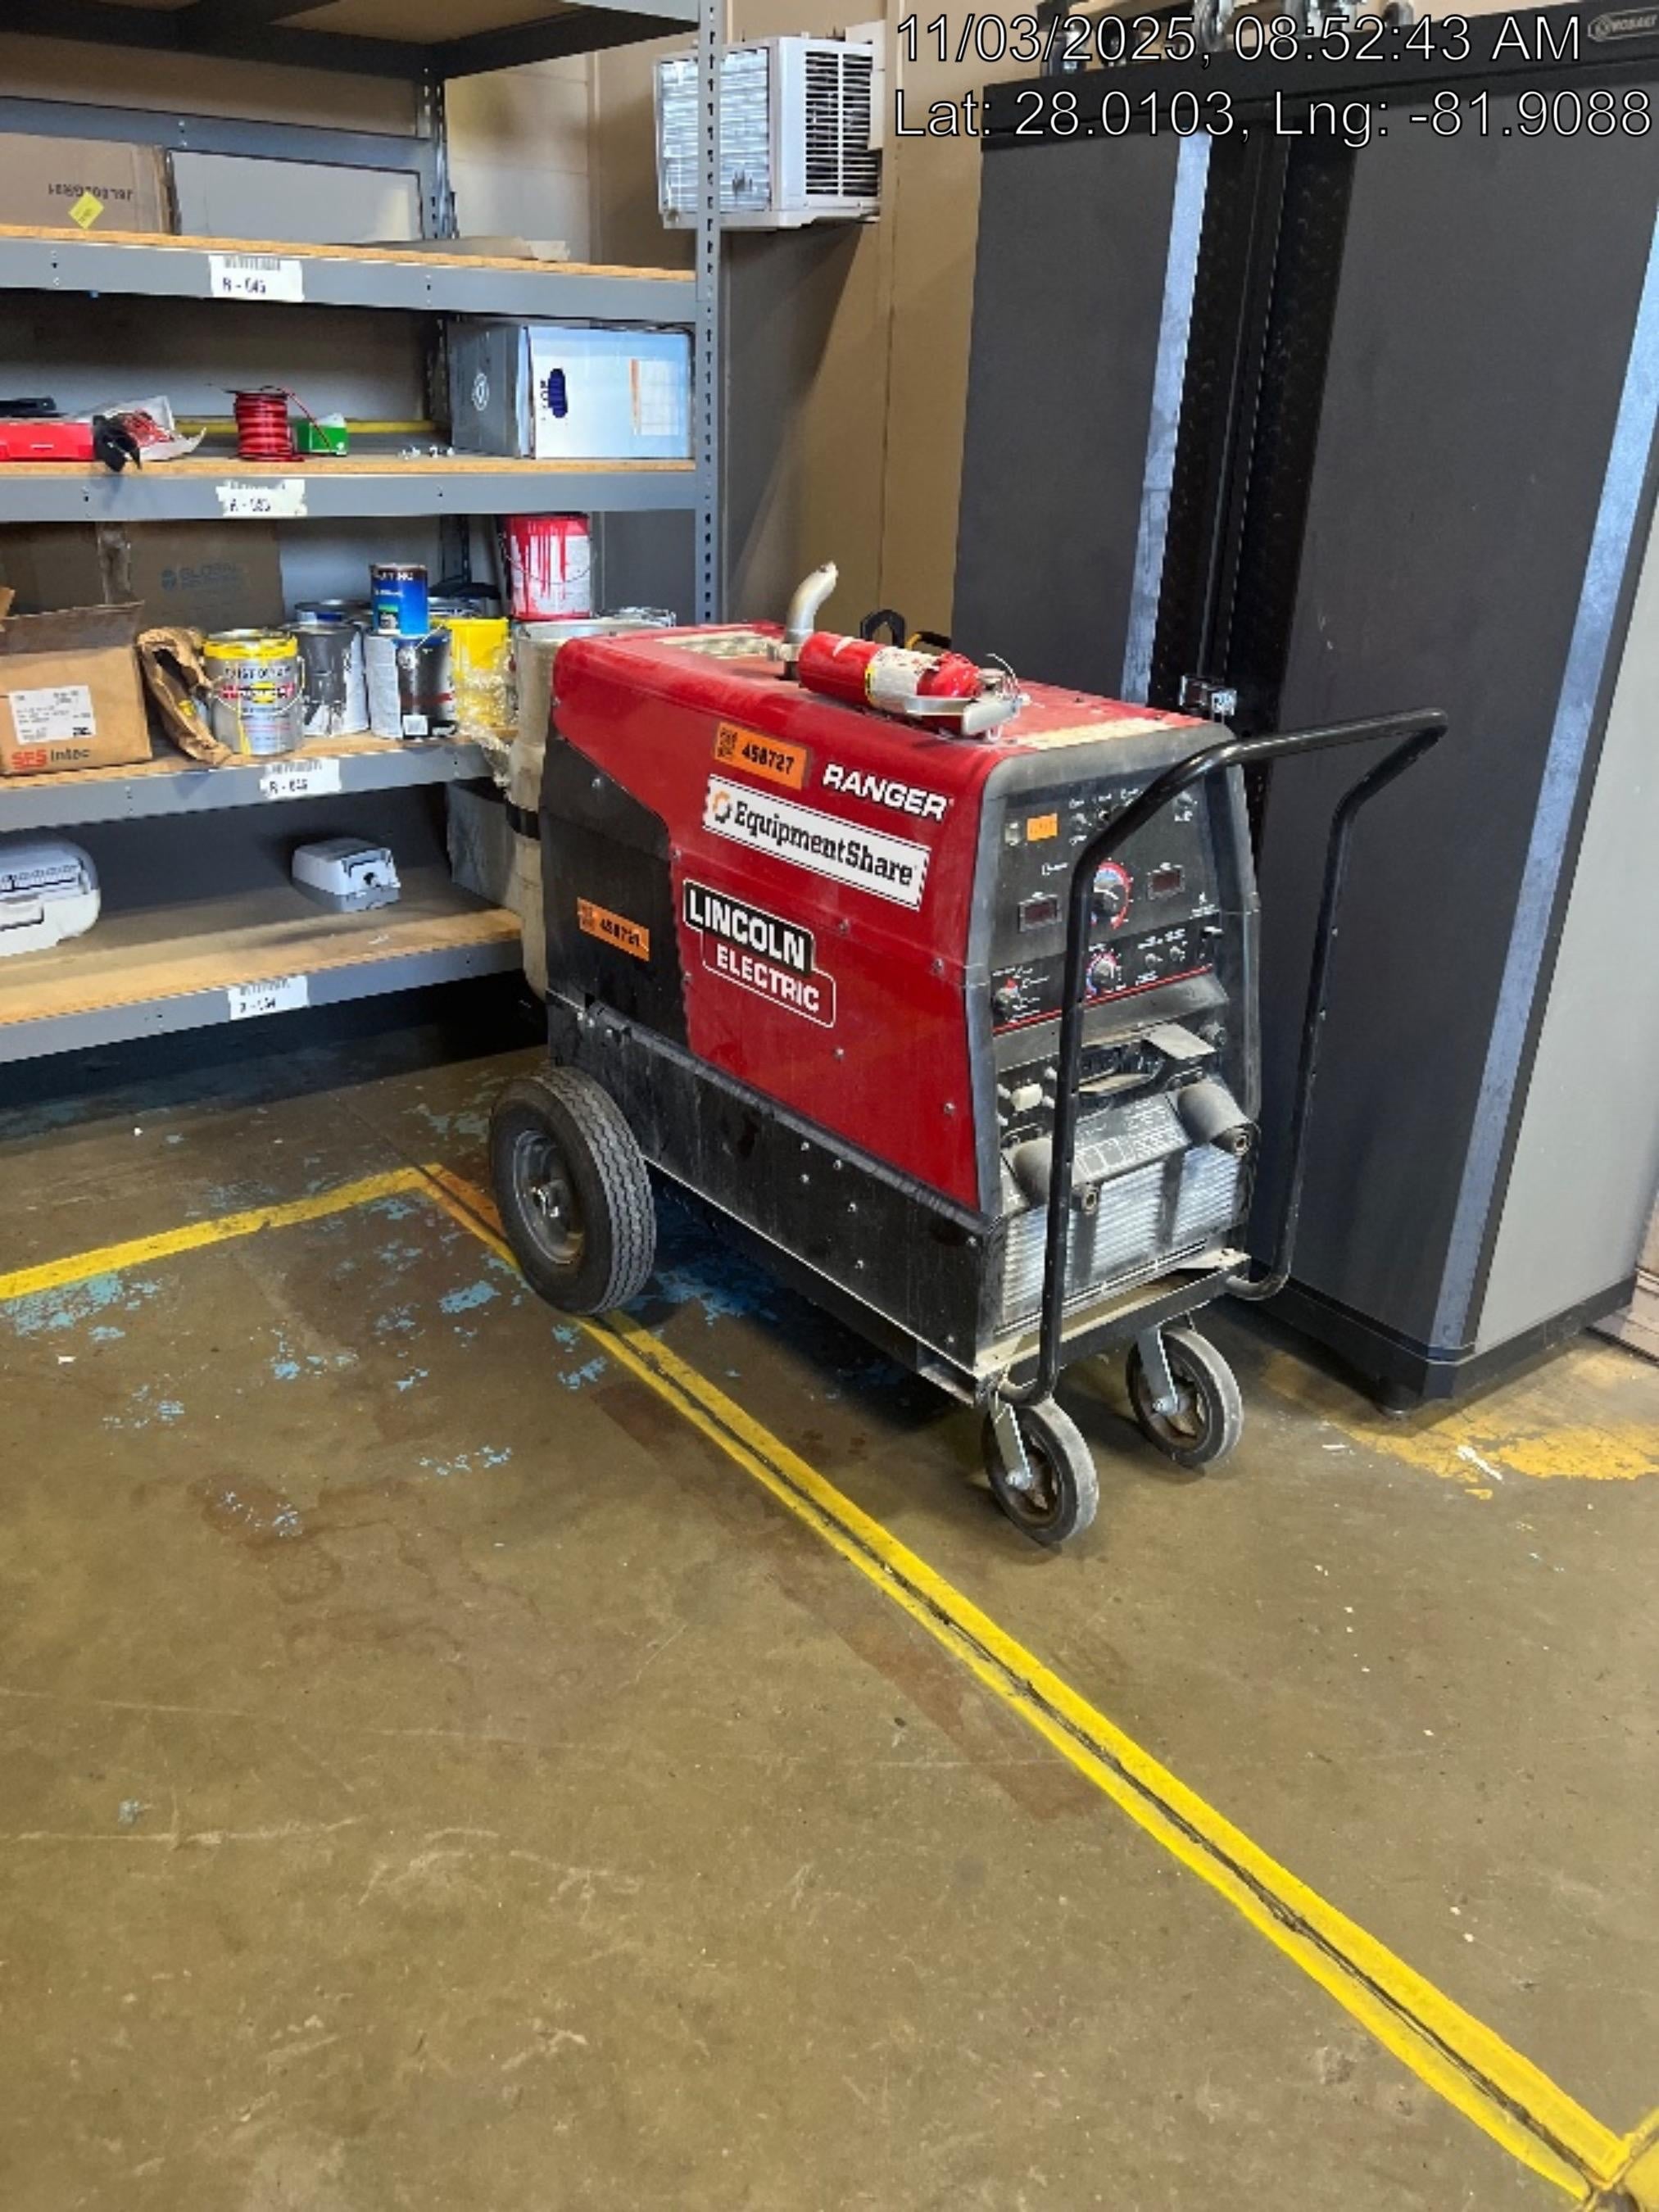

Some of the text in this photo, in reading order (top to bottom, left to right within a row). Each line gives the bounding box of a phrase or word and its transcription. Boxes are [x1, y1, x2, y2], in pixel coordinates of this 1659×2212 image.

[741, 742, 795, 776] 458727
[822, 763, 948, 822] RANGER
[733, 800, 914, 886] EquipmentShare
[689, 888, 805, 972] LINCOLN
[716, 942, 820, 1013] ELECTRIC
